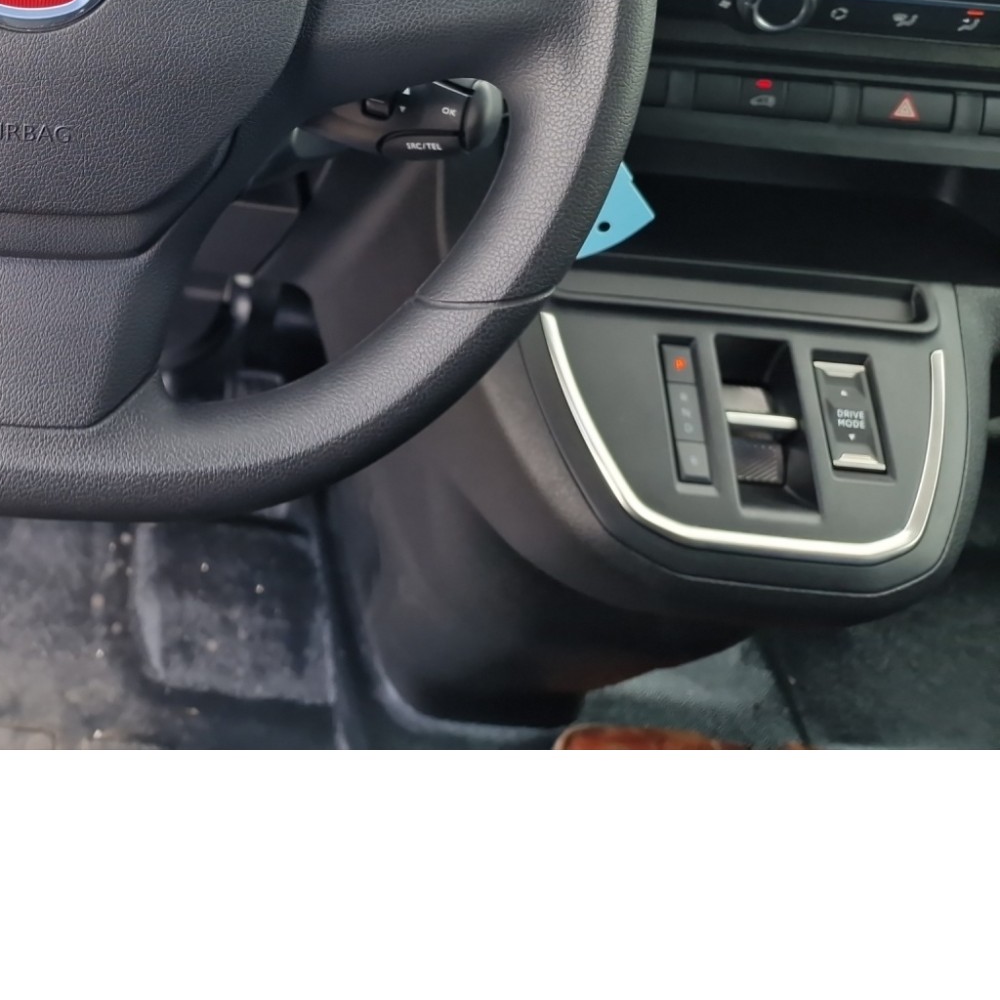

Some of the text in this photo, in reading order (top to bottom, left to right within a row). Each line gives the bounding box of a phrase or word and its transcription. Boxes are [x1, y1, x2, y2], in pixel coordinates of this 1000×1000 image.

[441, 106, 457, 117] OK
[406, 141, 443, 151] SRC/TEL
[837, 408, 865, 420] DRIVE
[837, 419, 866, 430] MODE
